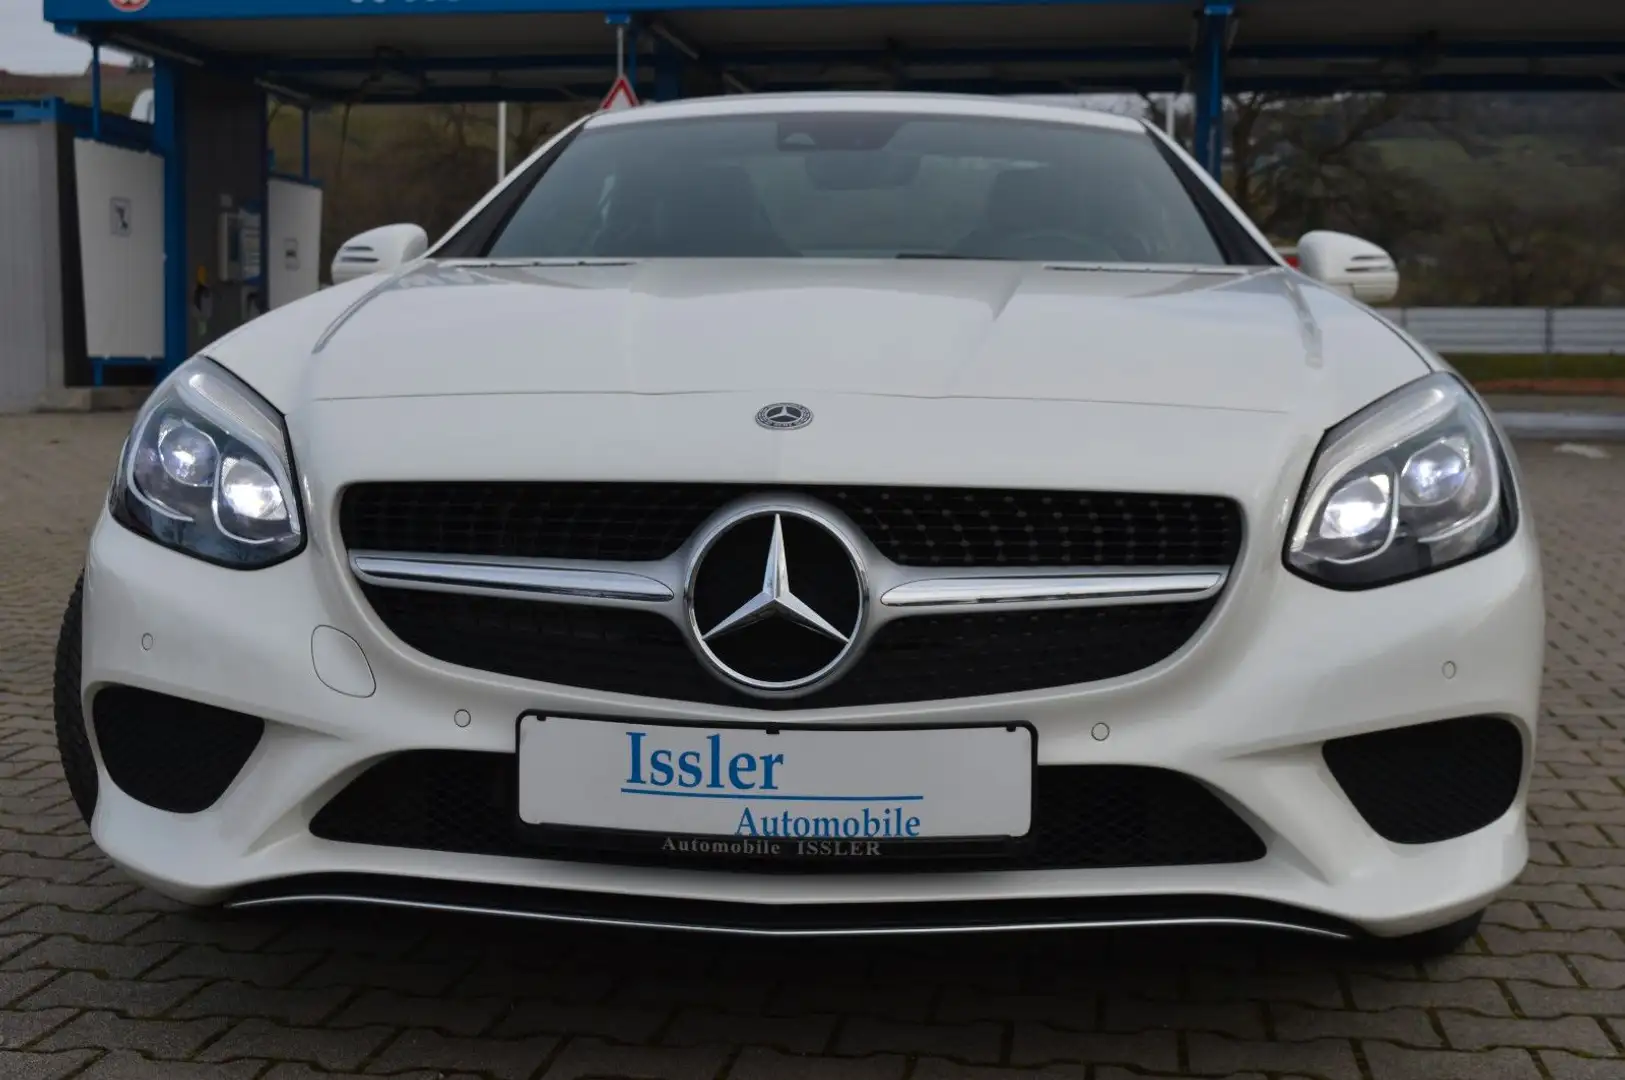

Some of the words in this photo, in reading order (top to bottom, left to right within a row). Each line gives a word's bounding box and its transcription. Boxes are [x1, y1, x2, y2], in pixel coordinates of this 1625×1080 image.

[626, 731, 784, 790] Issler
[735, 807, 921, 838] Automobile
[662, 837, 781, 855] Automobile
[798, 839, 882, 856] ISSLER
